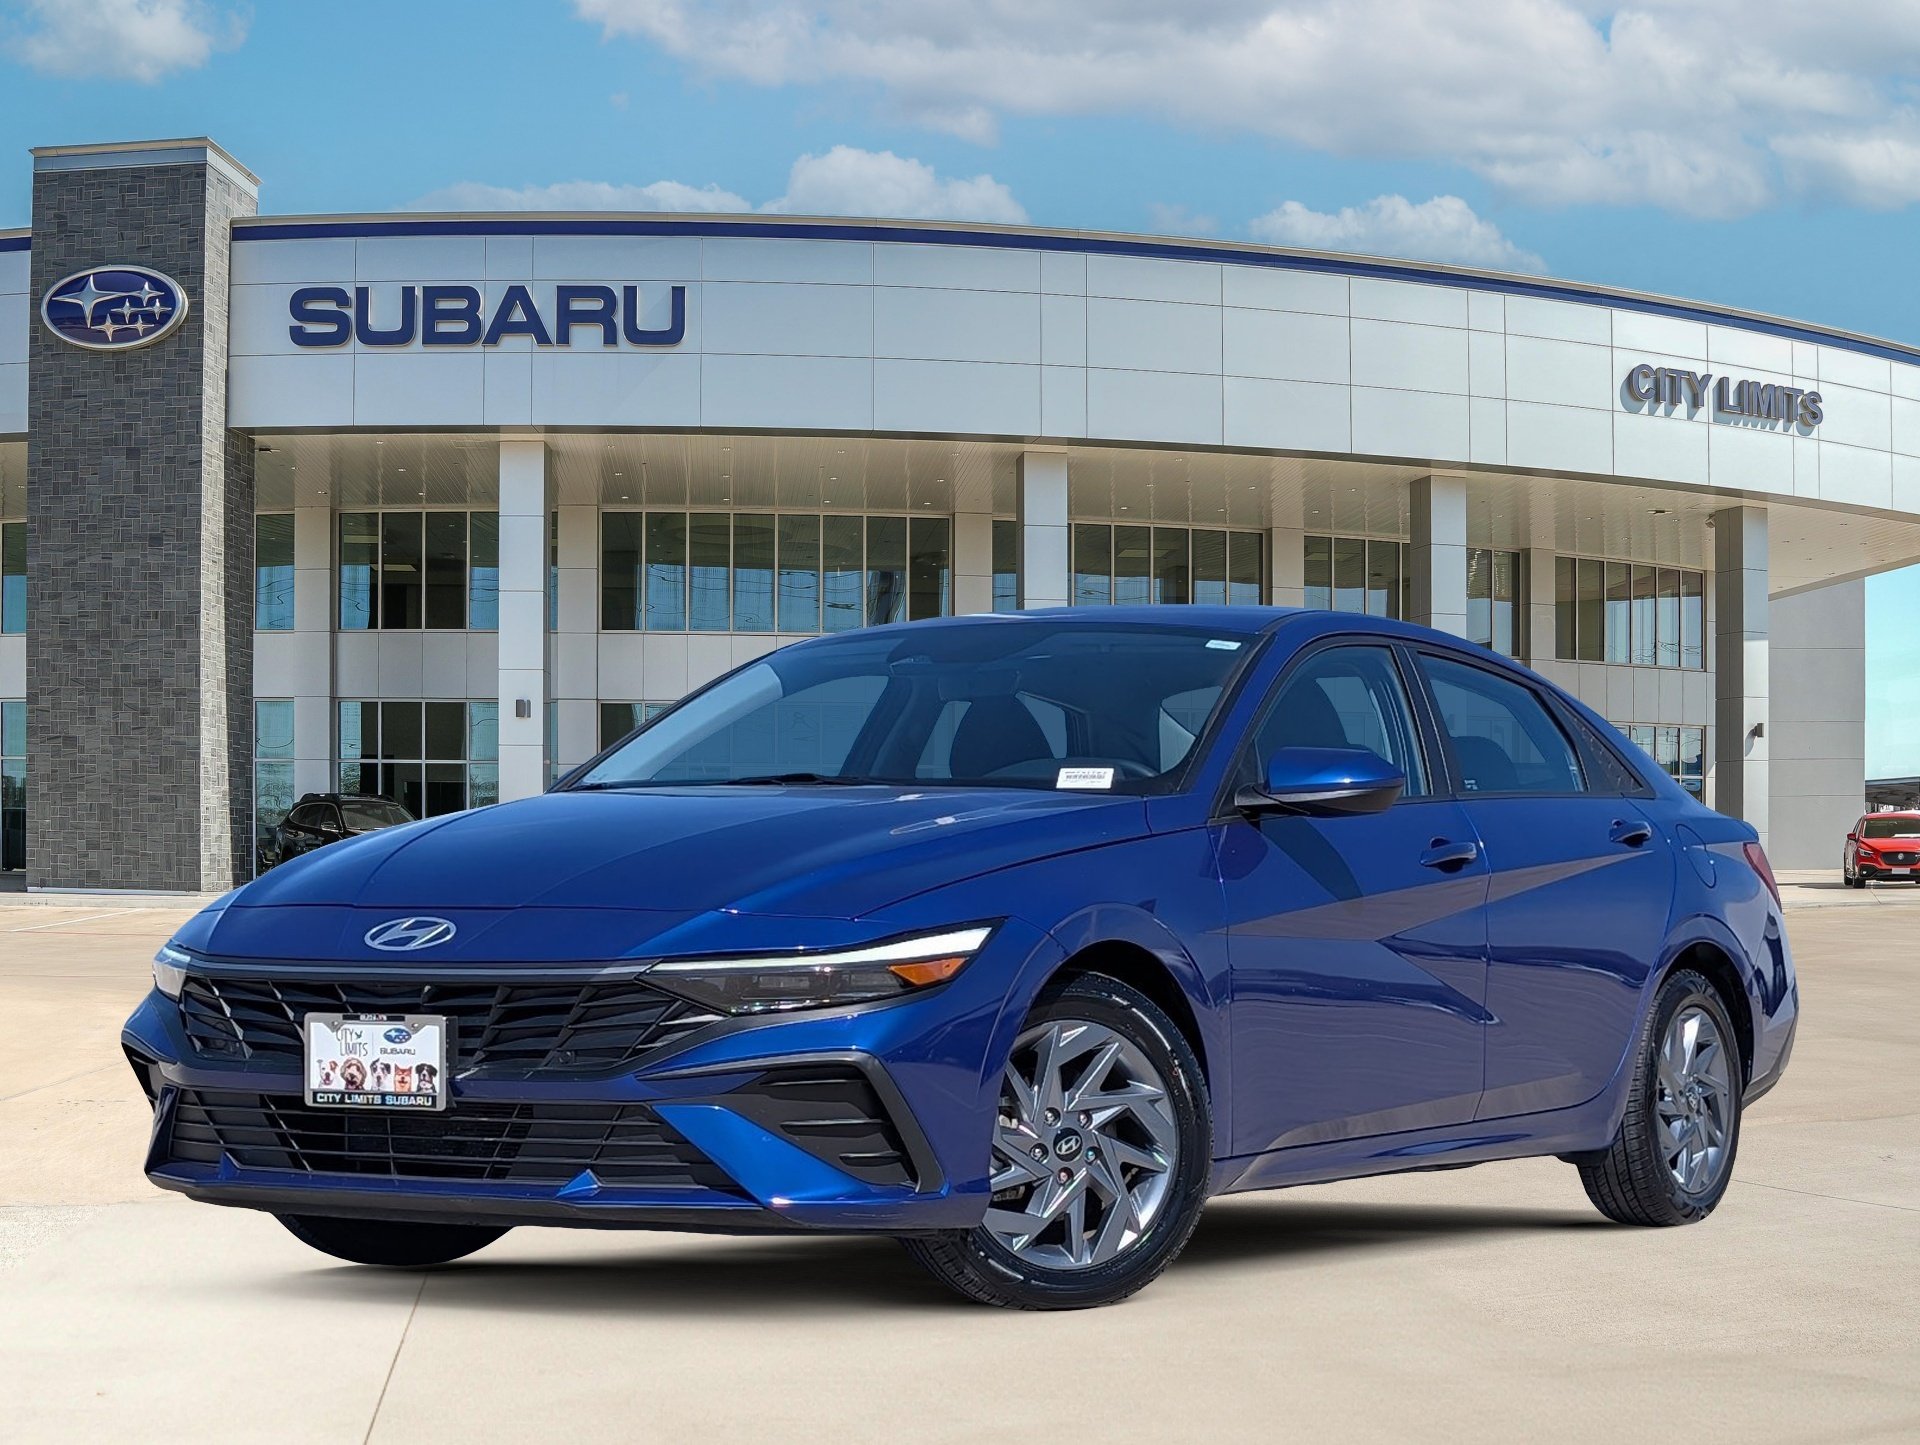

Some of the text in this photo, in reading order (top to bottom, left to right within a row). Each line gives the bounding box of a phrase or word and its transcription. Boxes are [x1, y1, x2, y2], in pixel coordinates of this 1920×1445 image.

[288, 285, 686, 346] SUBARU
[1630, 363, 1824, 426] CITY LIMITS
[336, 1028, 354, 1041] CITY
[380, 1047, 416, 1056] SUBARU
[316, 1093, 432, 1106] CITY LIMITS SUBARU
